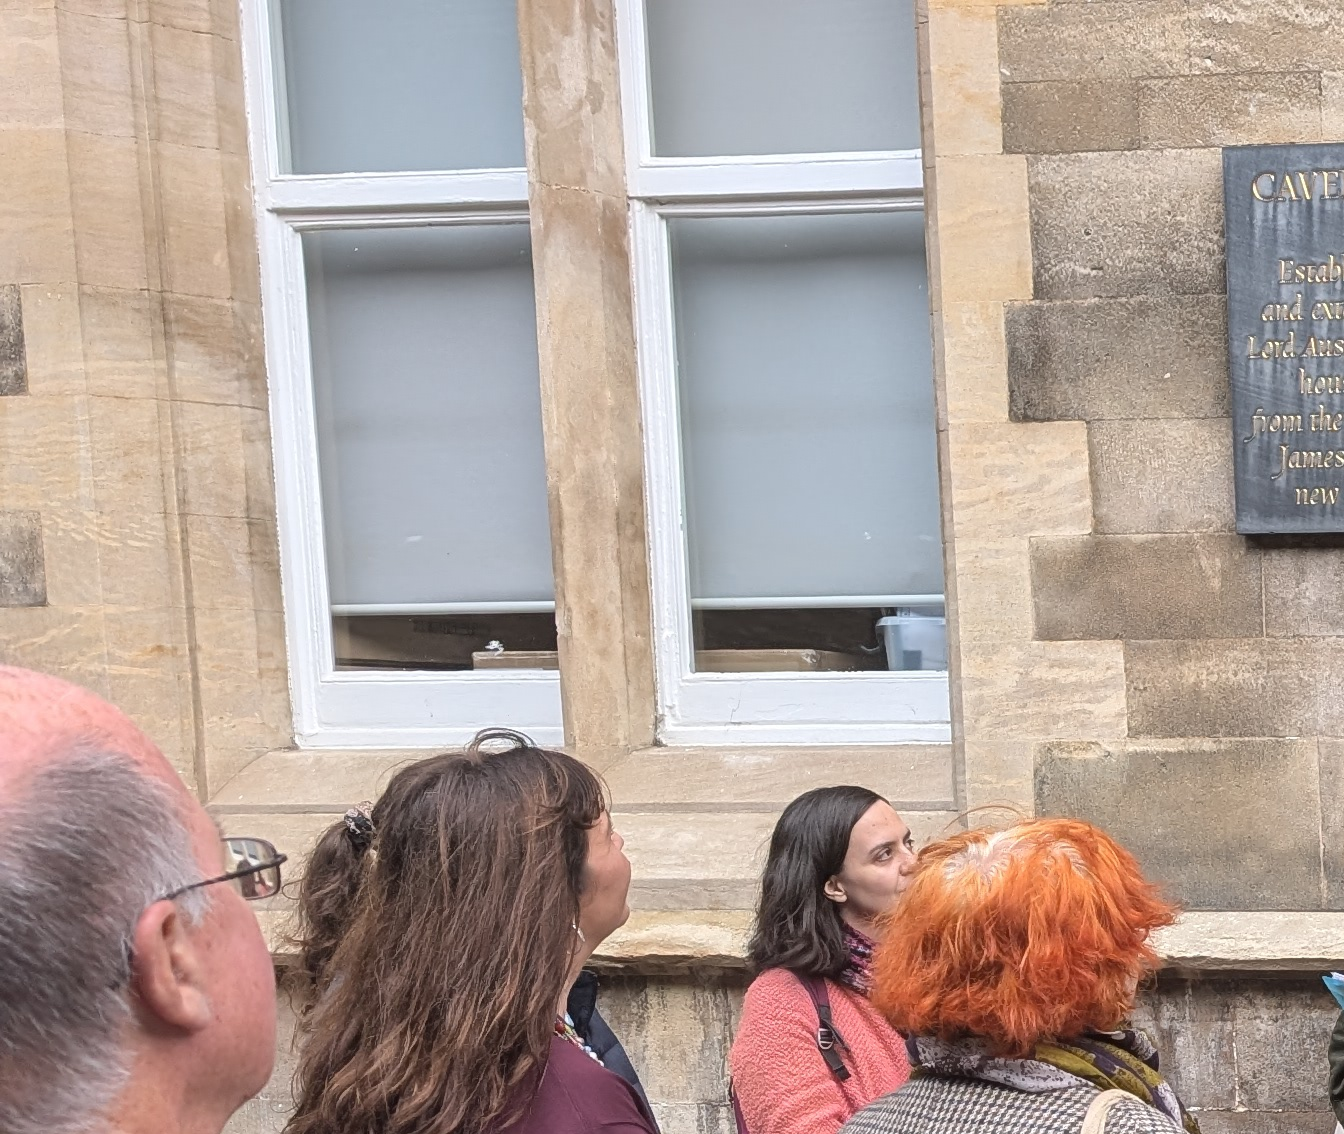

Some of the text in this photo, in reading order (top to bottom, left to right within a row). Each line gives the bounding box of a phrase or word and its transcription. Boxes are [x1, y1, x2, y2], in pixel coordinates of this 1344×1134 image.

[1261, 292, 1304, 322] and
[1247, 331, 1296, 360] Lord
[1243, 406, 1304, 443] from
[1310, 404, 1343, 432] the
[1295, 486, 1339, 506] new
